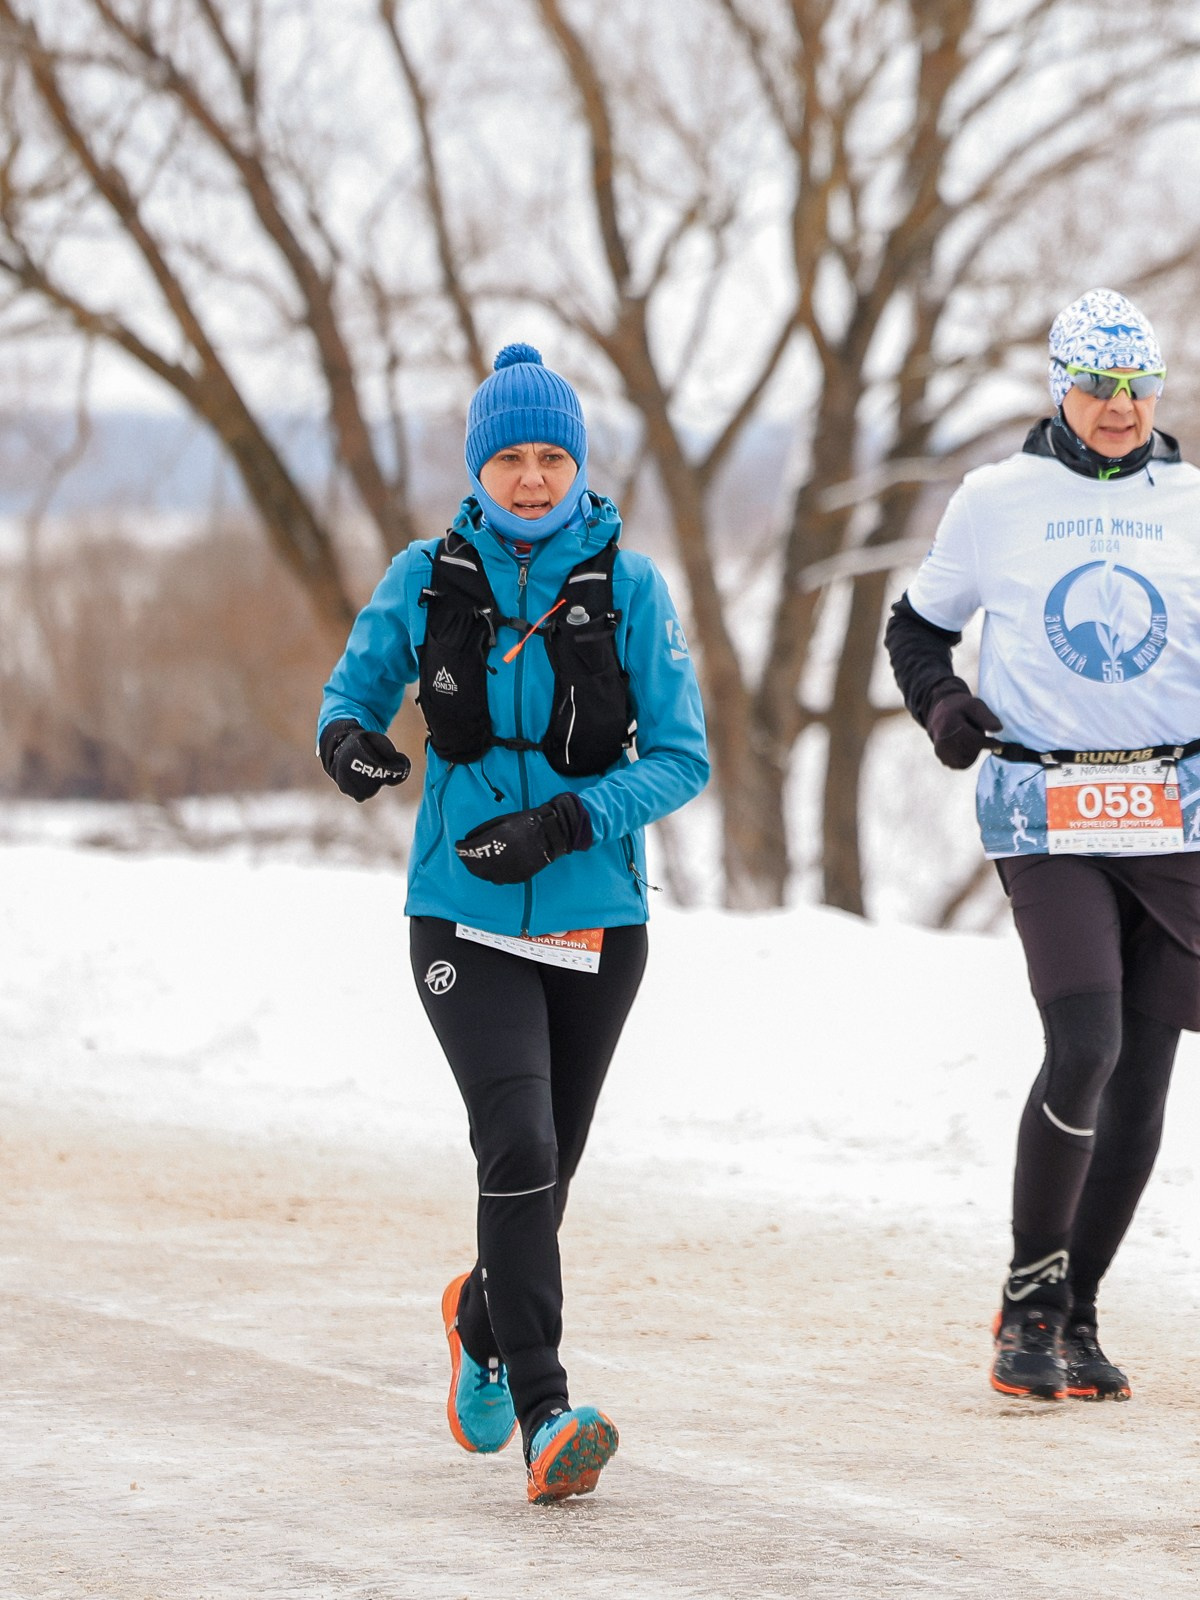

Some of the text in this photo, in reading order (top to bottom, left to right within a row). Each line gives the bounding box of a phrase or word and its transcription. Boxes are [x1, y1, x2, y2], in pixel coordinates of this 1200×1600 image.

[1045, 518, 1163, 541] ДОРОГА ЖИЗНИ
[1090, 540, 1120, 553] 2024
[1044, 615, 1088, 673] ЗИМНИЙ
[1102, 660, 1124, 683] 55
[1074, 749, 1154, 764] RUNLAB
[1077, 785, 1154, 819] 058
[1069, 818, 1164, 830] КУЗНЕЦОВ ДМИТРИЙ
